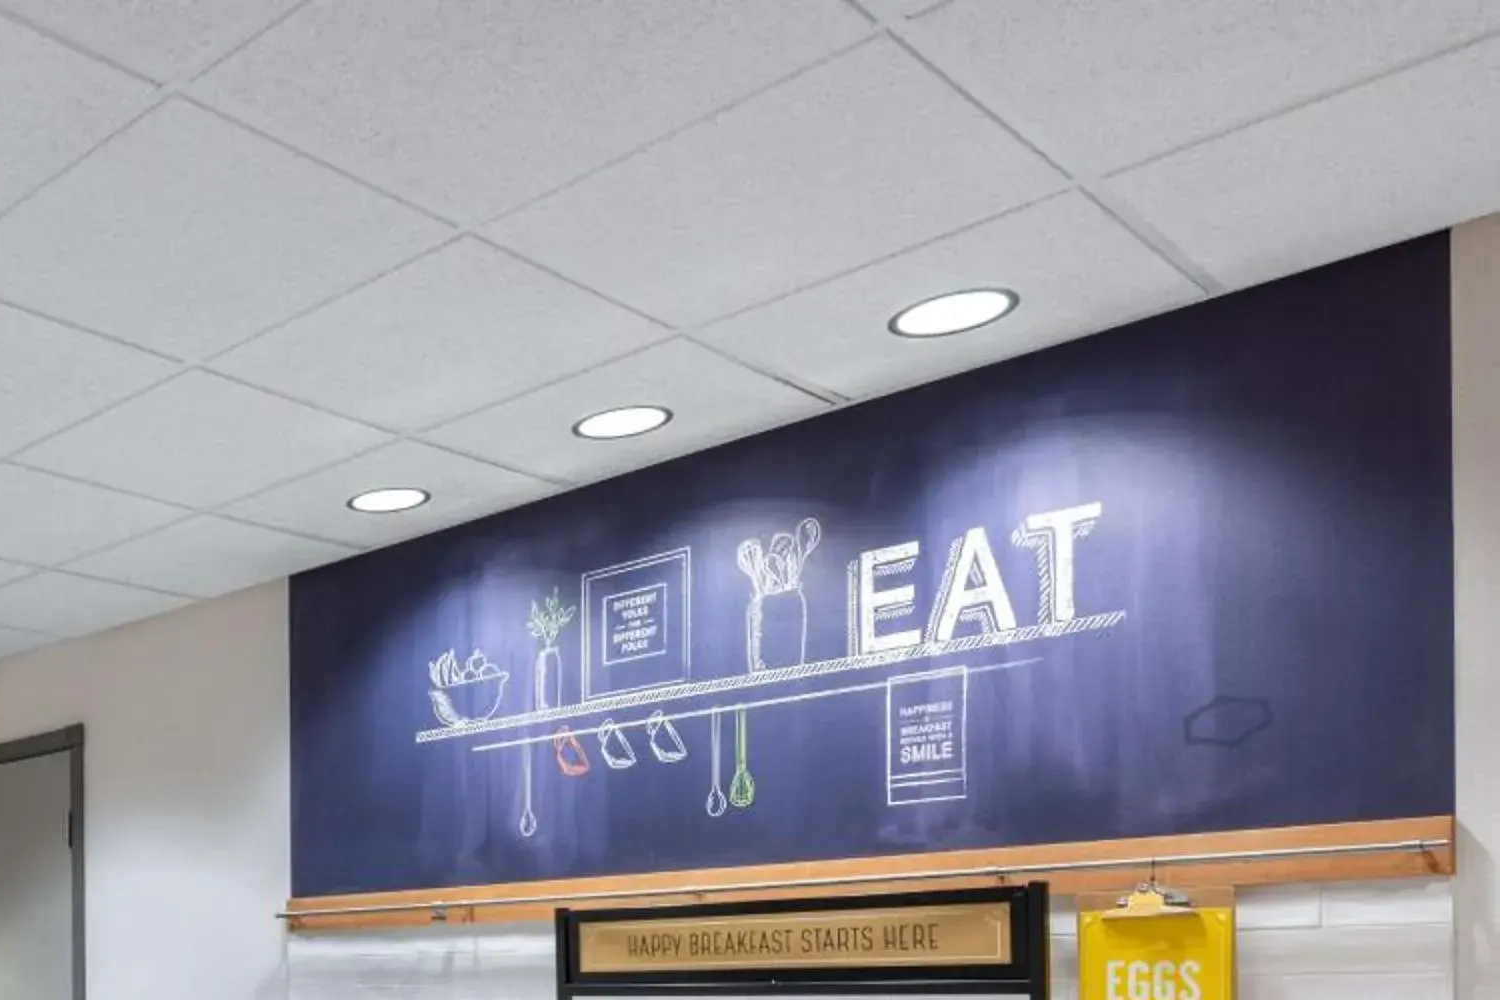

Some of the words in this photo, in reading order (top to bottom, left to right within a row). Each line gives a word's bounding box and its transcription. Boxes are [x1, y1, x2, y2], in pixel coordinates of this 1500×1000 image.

[848, 502, 1102, 656] EAT
[900, 741, 954, 764] SMILE
[628, 934, 683, 957] HAPPY
[689, 929, 794, 956] BREAKFAST
[801, 927, 873, 953] STARTS
[883, 923, 941, 950] HERE
